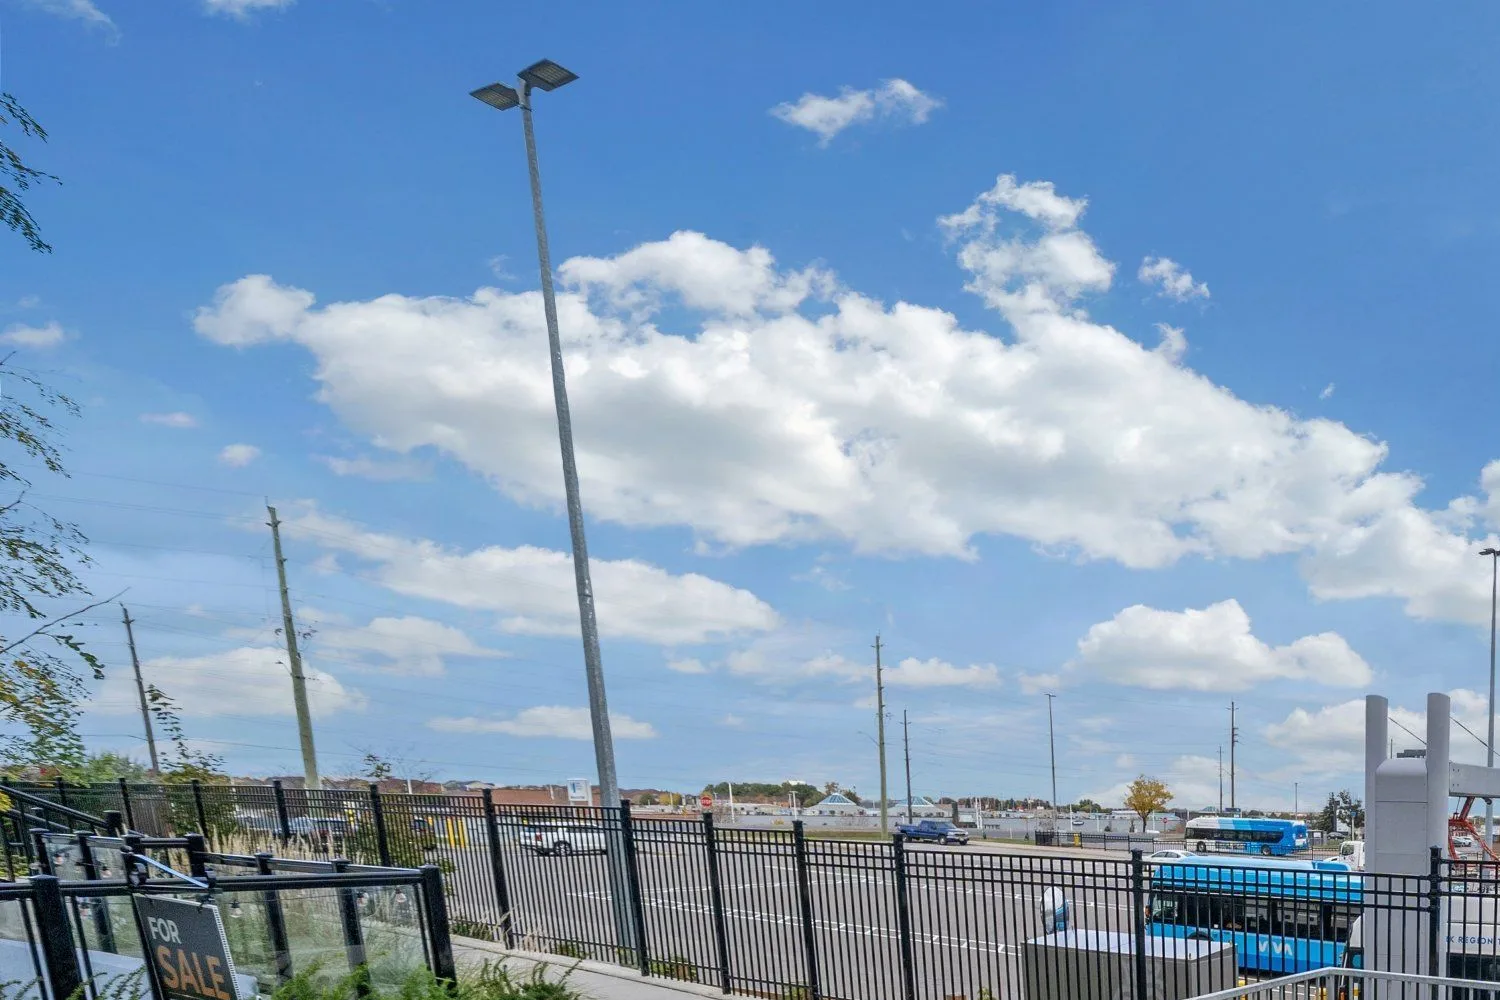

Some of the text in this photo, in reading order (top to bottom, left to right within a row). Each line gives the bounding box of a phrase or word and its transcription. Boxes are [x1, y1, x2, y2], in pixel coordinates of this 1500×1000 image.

[147, 916, 182, 944] FOR
[1458, 936, 1493, 945] REGION
[157, 945, 231, 1000] SALE
